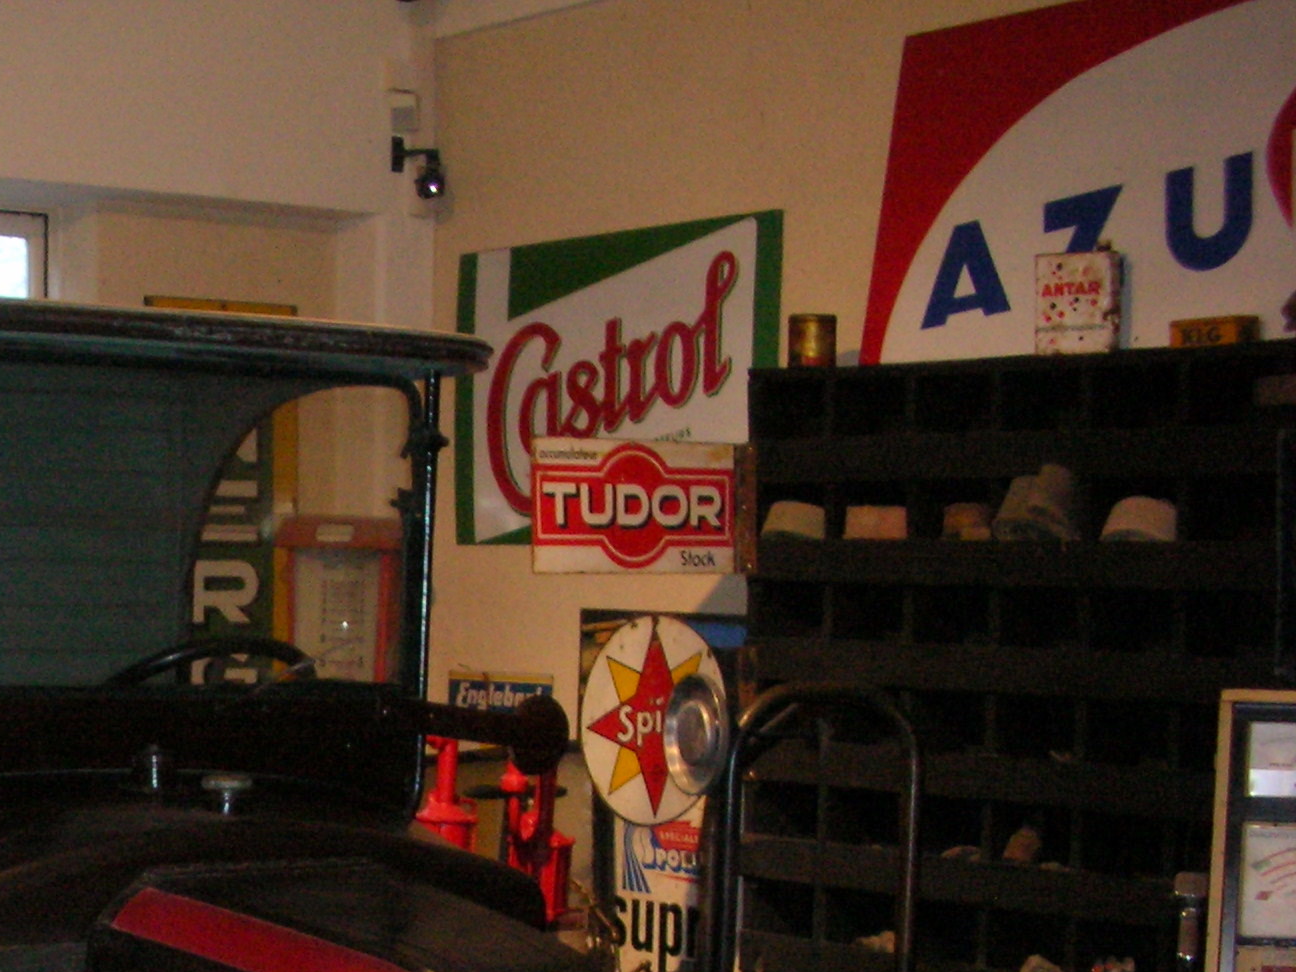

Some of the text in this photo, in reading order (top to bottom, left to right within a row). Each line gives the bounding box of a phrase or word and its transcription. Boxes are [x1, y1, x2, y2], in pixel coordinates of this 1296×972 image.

[921, 151, 1296, 330] AZU
[1040, 280, 1103, 298] ANTAR
[487, 250, 739, 517] Castrol
[542, 481, 723, 530] TUDOR
[680, 550, 716, 567] Stock
[616, 704, 663, 747] Spi
